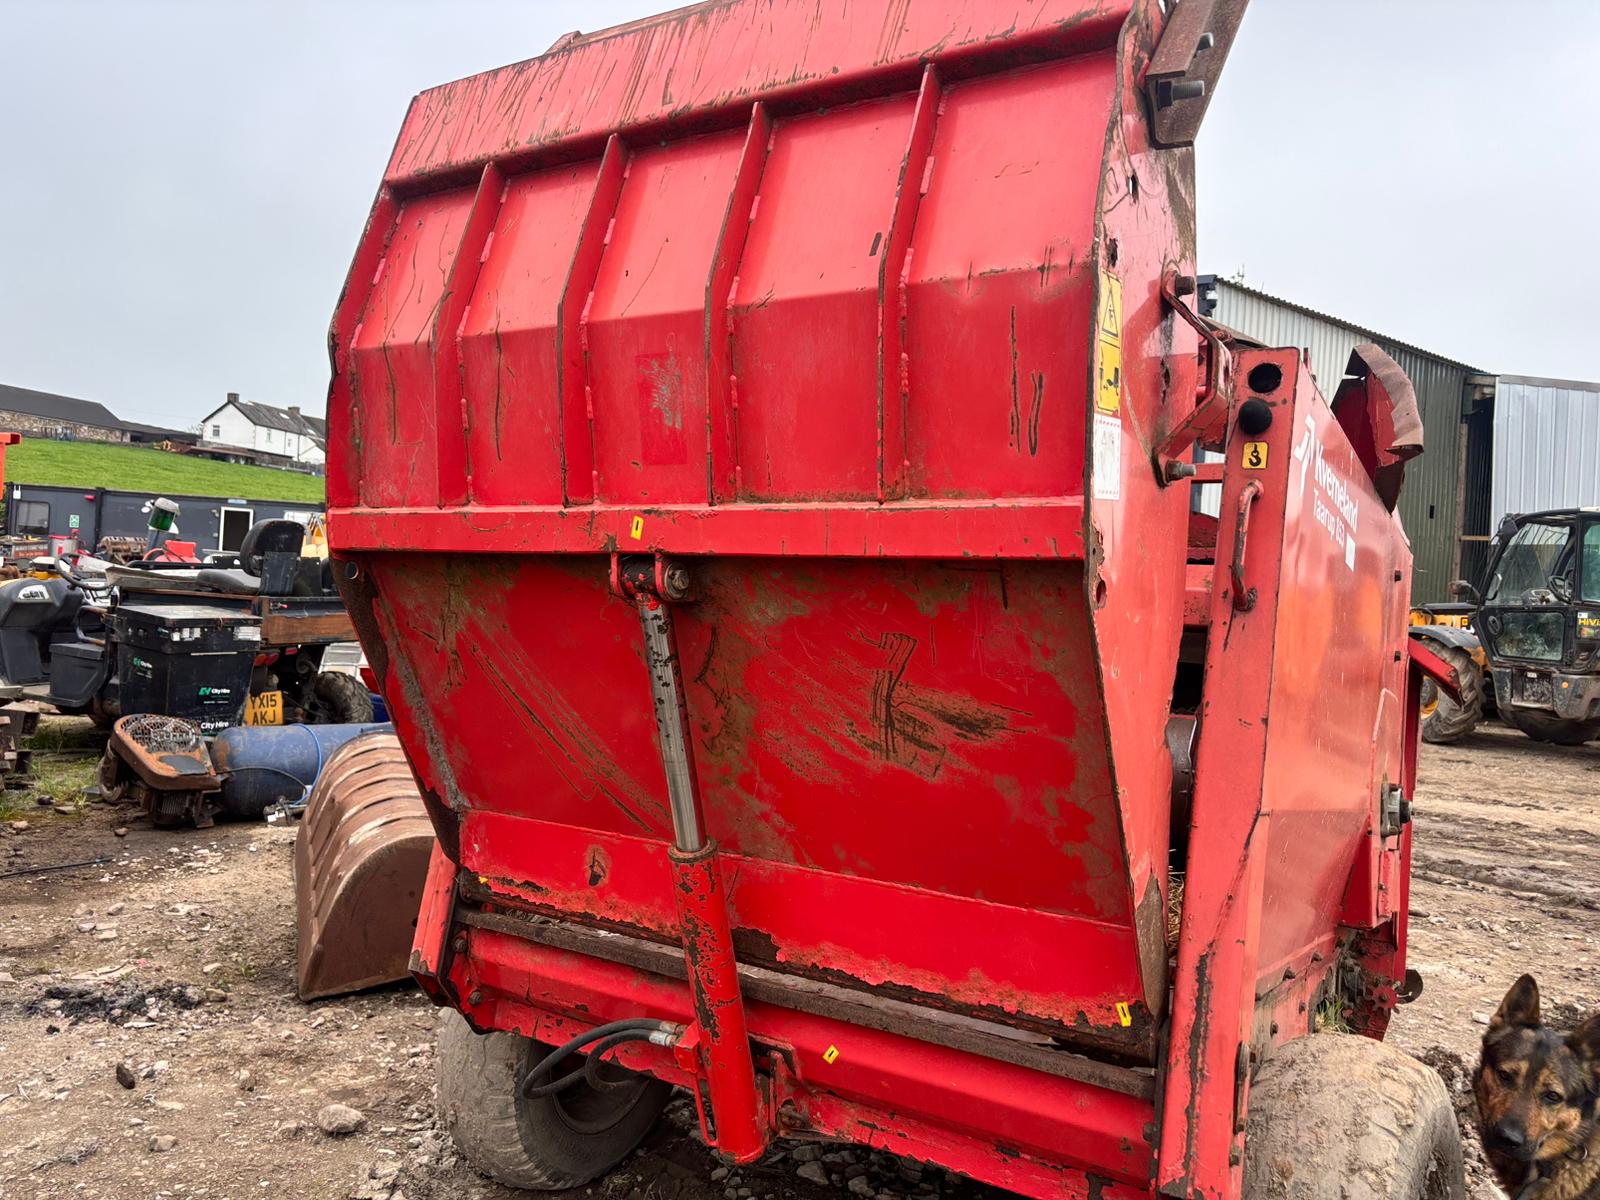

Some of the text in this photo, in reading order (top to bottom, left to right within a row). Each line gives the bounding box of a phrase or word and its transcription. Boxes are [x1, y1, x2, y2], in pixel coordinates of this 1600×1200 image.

[1314, 438, 1359, 534] Kverneland
[250, 693, 277, 710] YX15
[200, 720, 229, 730] City Hire
[252, 709, 276, 726] AKJ
